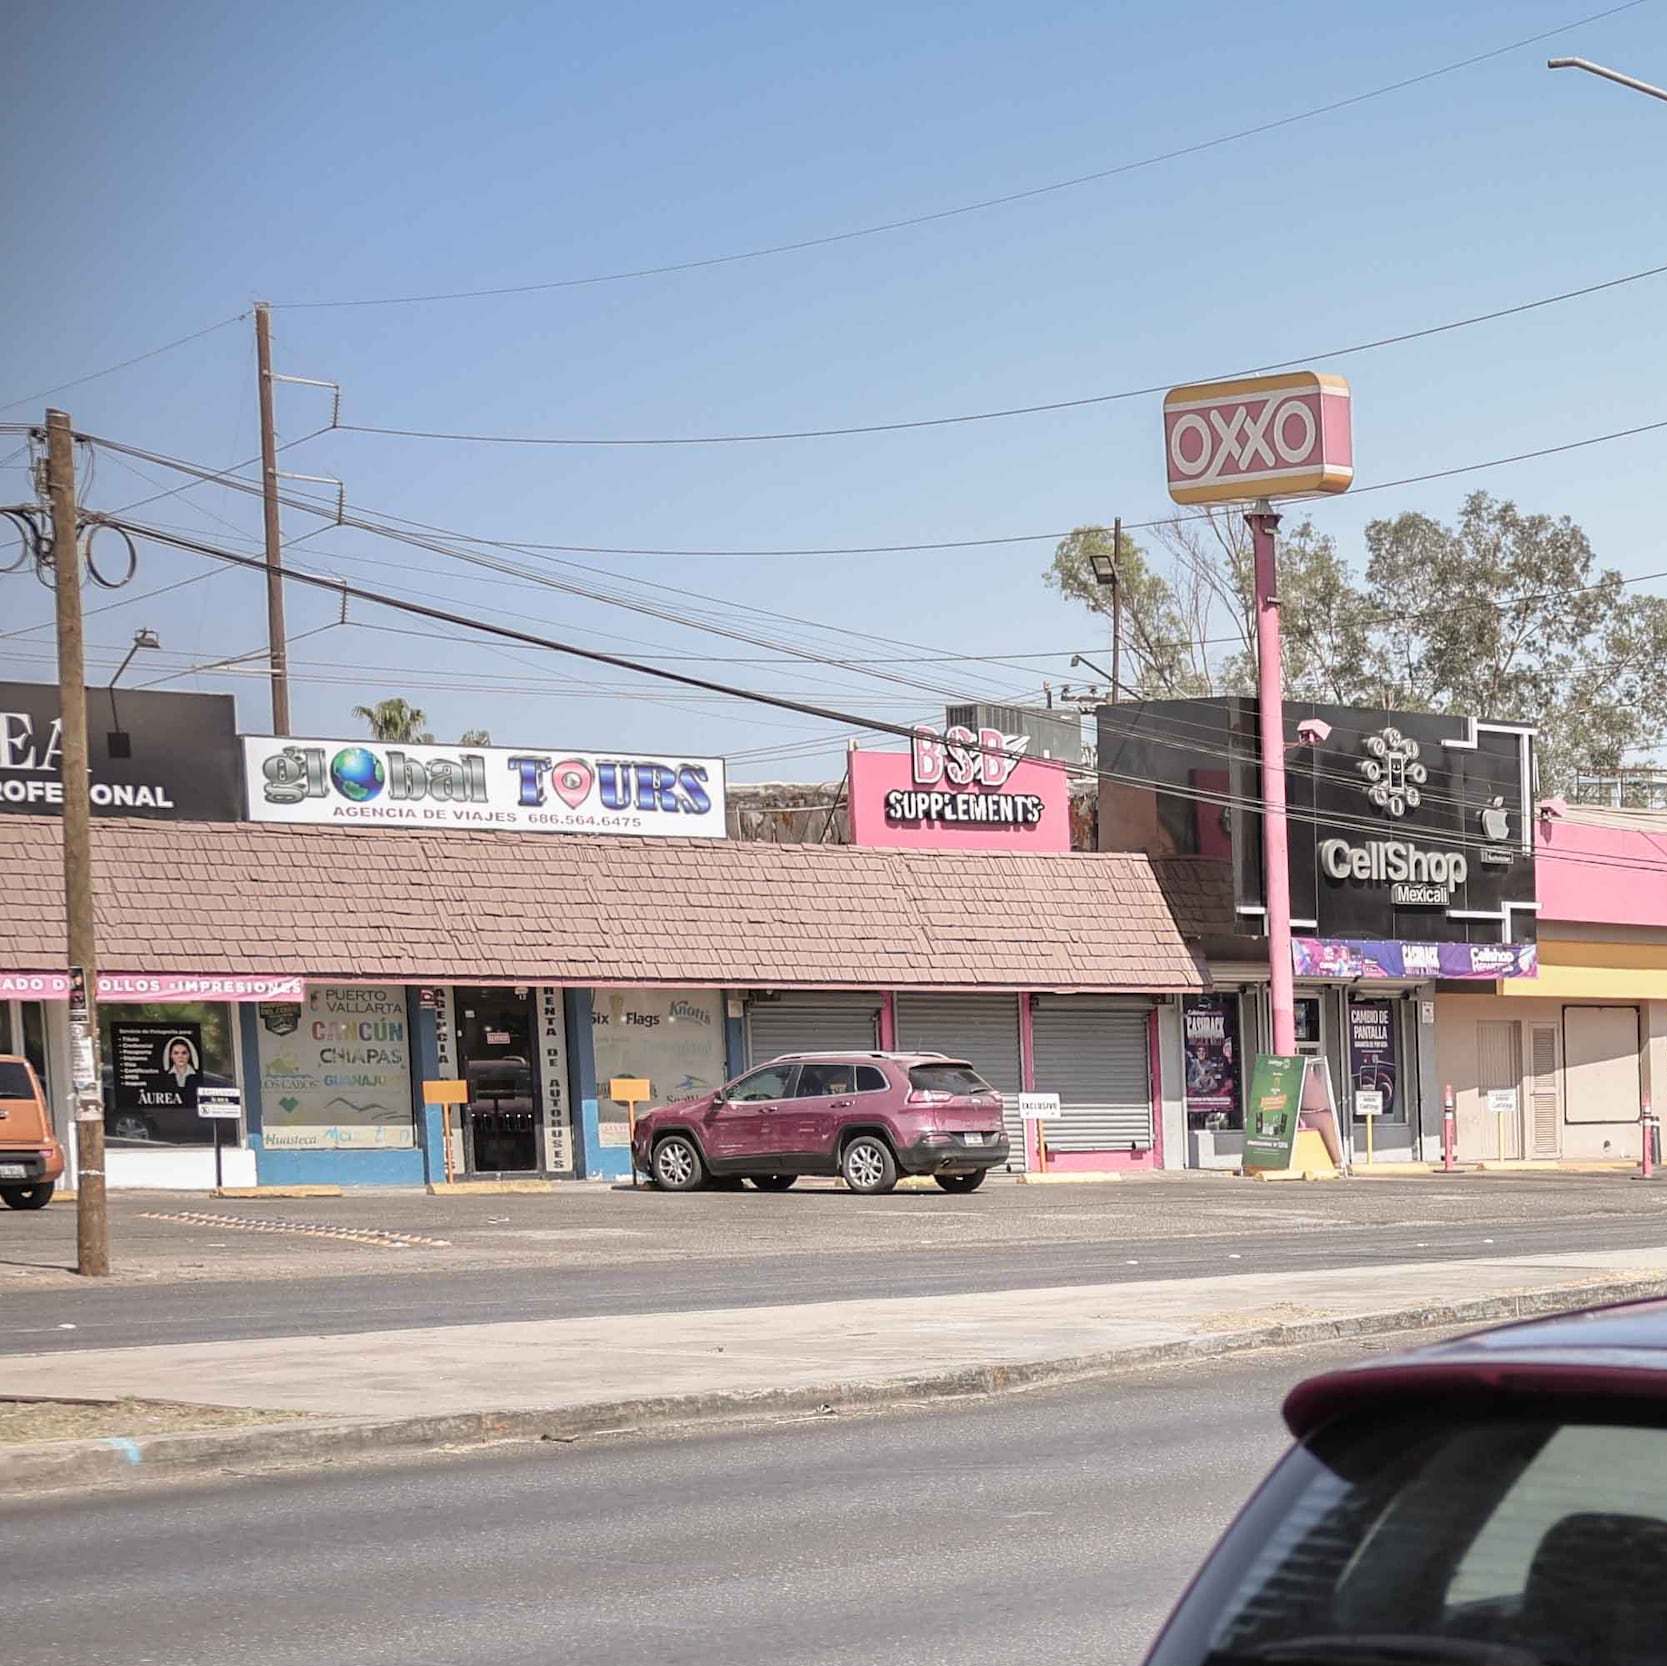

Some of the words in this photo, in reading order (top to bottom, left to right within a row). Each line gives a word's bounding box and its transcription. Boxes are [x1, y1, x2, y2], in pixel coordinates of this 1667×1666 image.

[1171, 399, 1316, 477] OXXO
[507, 753, 712, 815] TOURS
[888, 791, 1042, 822] SUPPLEMENTS
[333, 806, 418, 820] AGENCIA
[423, 809, 447, 821] DE
[452, 810, 518, 823] VIAJES
[528, 813, 643, 828] 686.564.6475
[1321, 839, 1468, 892] CellShop
[1398, 885, 1447, 903] Mexicali
[98, 979, 160, 992] OLLOS
[326, 990, 387, 1001] PUERTO
[326, 1002, 402, 1014] VALLARTA
[1351, 1010, 1378, 1024] CAMBIO
[1379, 1010, 1389, 1024] DE
[626, 1012, 660, 1027] Flags
[312, 1018, 404, 1041] CANCÚN
[1354, 1025, 1388, 1040] PANTALLA
[320, 1047, 402, 1064] CHIAPAS
[547, 1048, 558, 1067] DE
[549, 1080, 565, 1168] AUTOBUSES
